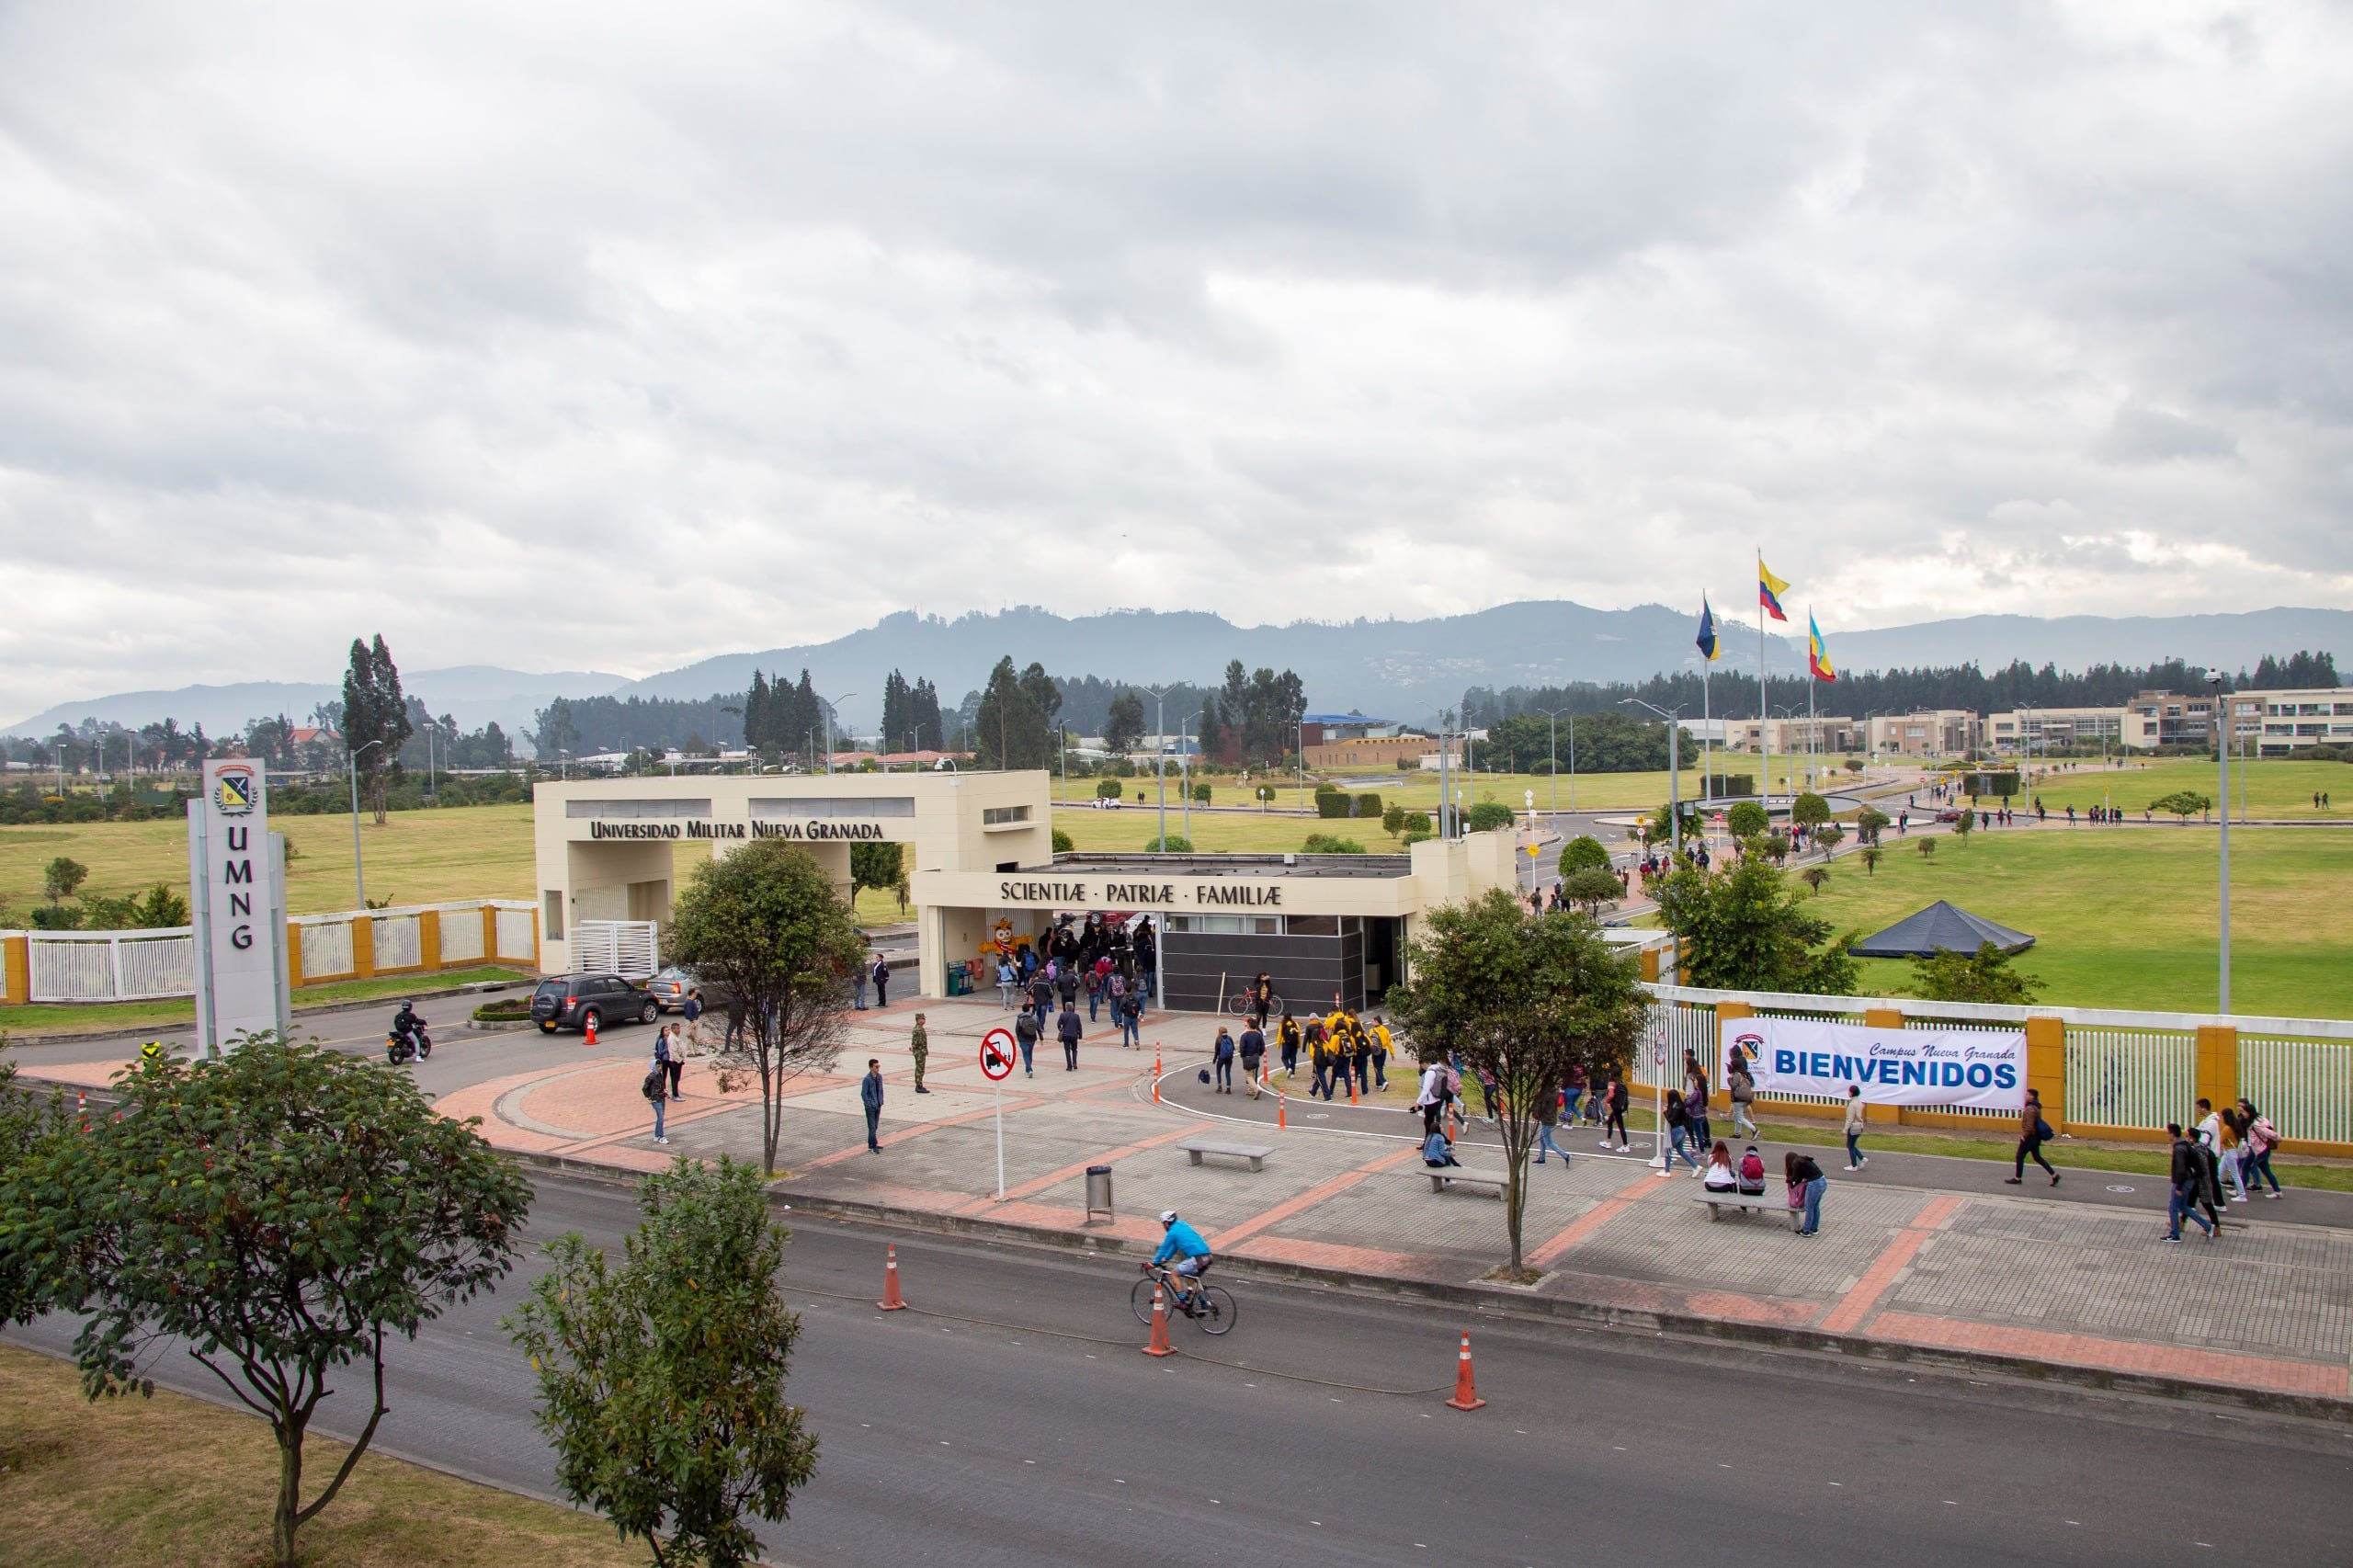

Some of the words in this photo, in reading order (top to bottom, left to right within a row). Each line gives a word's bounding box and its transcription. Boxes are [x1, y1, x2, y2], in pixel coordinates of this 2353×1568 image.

[591, 821, 680, 839] UNIVERSIDAD
[687, 820, 745, 838] MILITAR
[752, 820, 802, 839] NUEVA
[806, 820, 883, 840] GRANADA
[225, 826, 253, 949] UMNG
[1001, 881, 1086, 902] SCIENTIÆ
[1107, 884, 1174, 903] PATRIÆ
[1197, 885, 1281, 905] FAMILIÆ
[1869, 1042, 1916, 1060] Campus
[1922, 1044, 1960, 1058] Nueva
[1964, 1046, 2016, 1062] Granada
[1776, 1050, 2017, 1089] BIENVENIDOS
